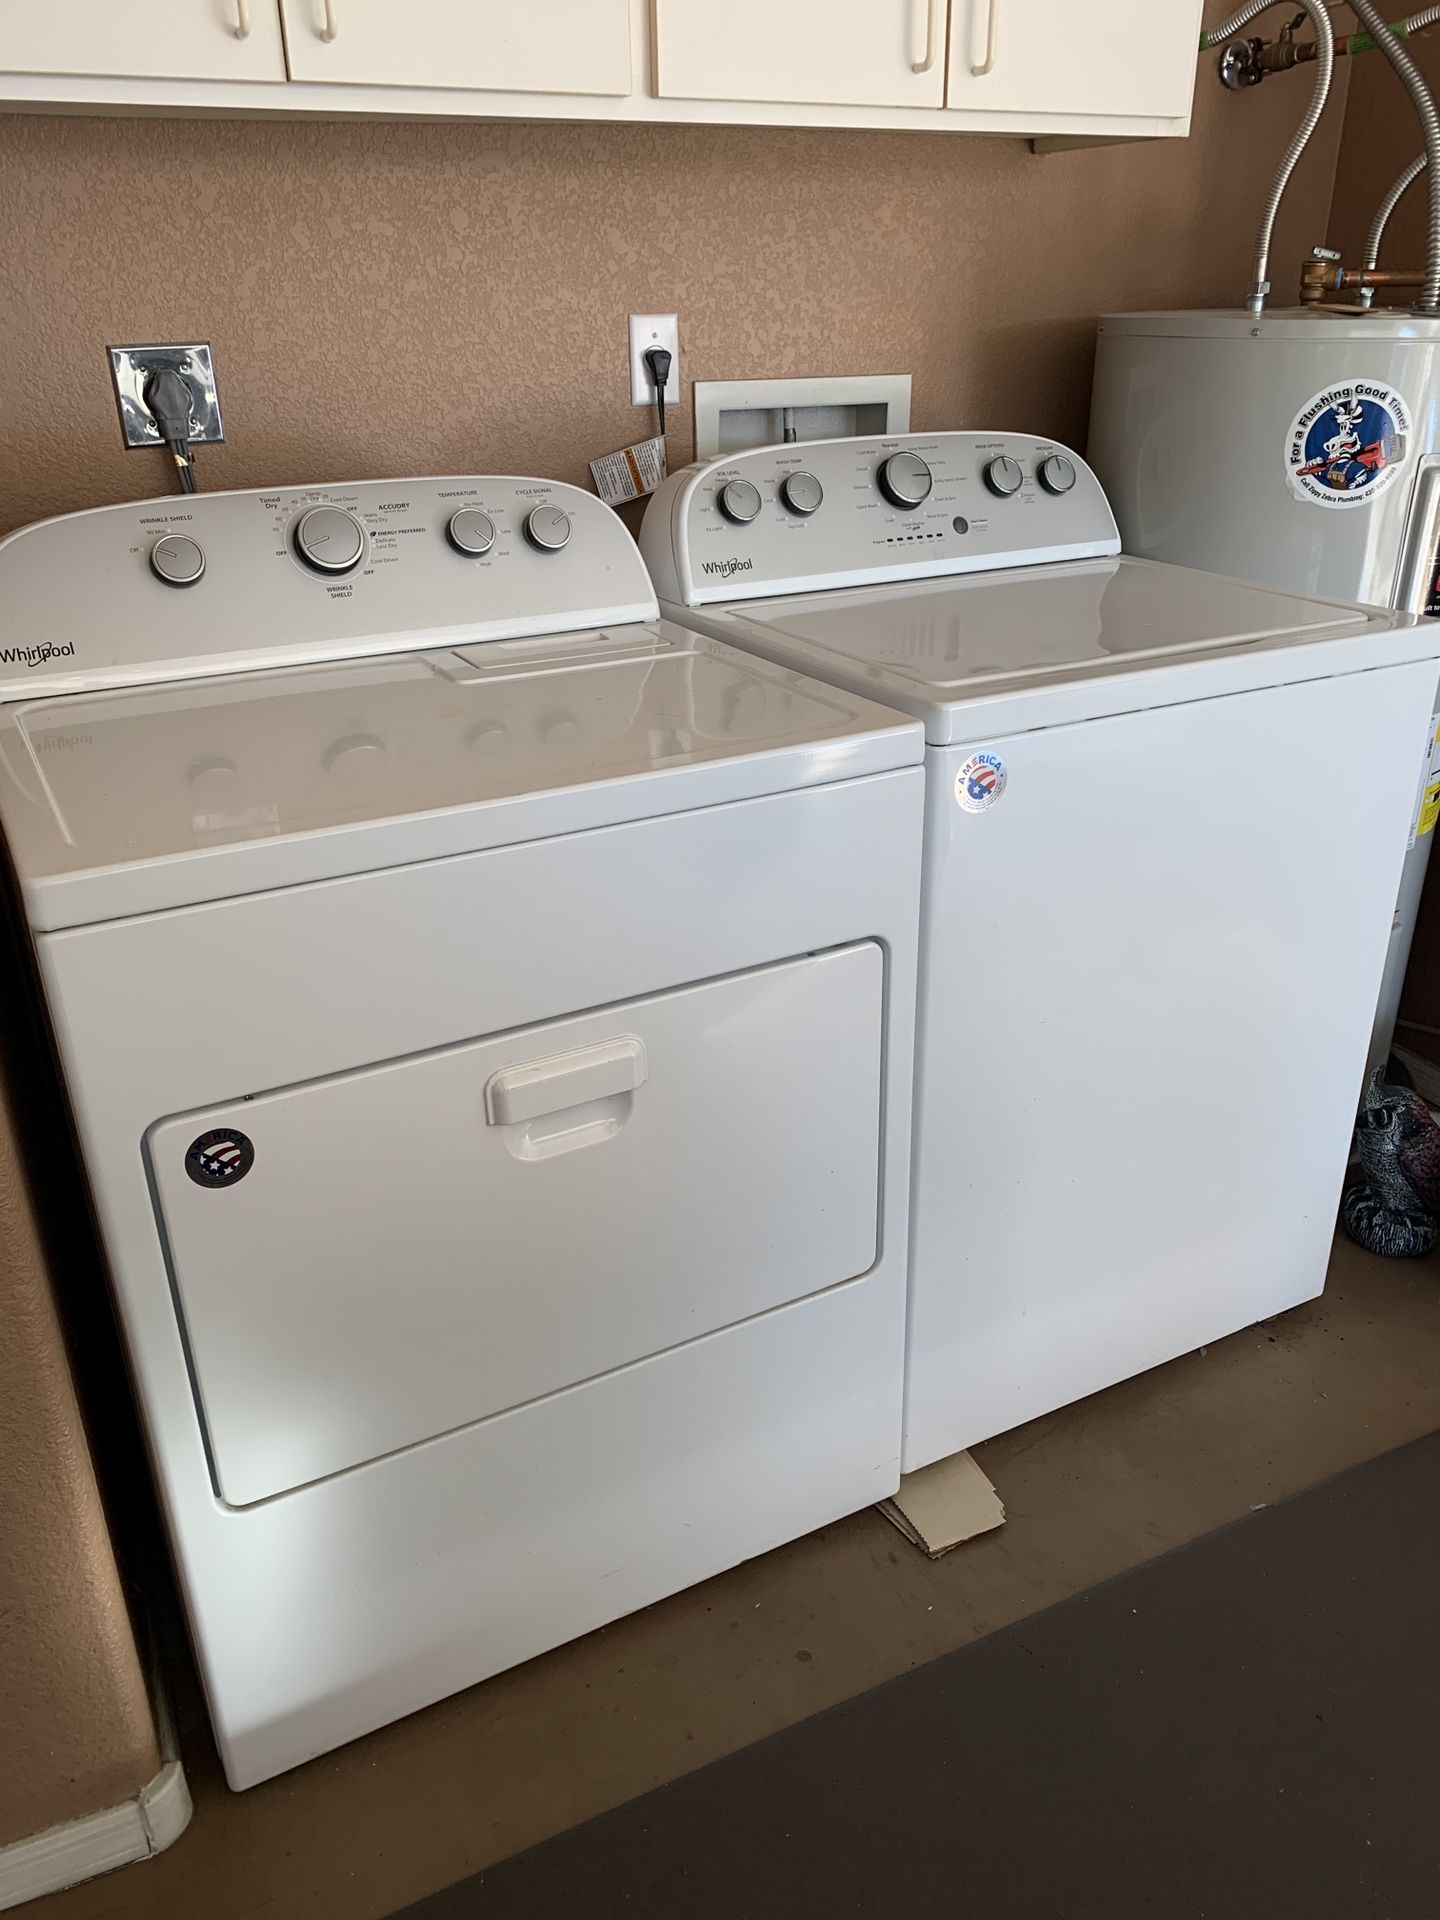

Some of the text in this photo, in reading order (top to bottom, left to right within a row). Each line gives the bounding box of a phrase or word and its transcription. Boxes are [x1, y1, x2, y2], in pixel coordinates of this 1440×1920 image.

[1355, 384, 1389, 400] Good
[1299, 388, 1351, 427] Flushing
[1295, 431, 1304, 439] a
[1290, 442, 1301, 466] For
[438, 489, 478, 498] TEMPERATURE
[1301, 477, 1309, 489] Call
[1308, 485, 1321, 499] Zippy
[1321, 493, 1337, 502] Zebra
[260, 496, 281, 504] Timed
[378, 502, 410, 511] ACCUDRY
[139, 514, 193, 525] WRINKLE SHIELD
[702, 557, 753, 579] Whirlpool
[326, 585, 353, 593] WRINKLE
[330, 591, 353, 599] SHIELD
[0, 641, 75, 667] Whirlpool
[958, 754, 1002, 785] AMERICA
